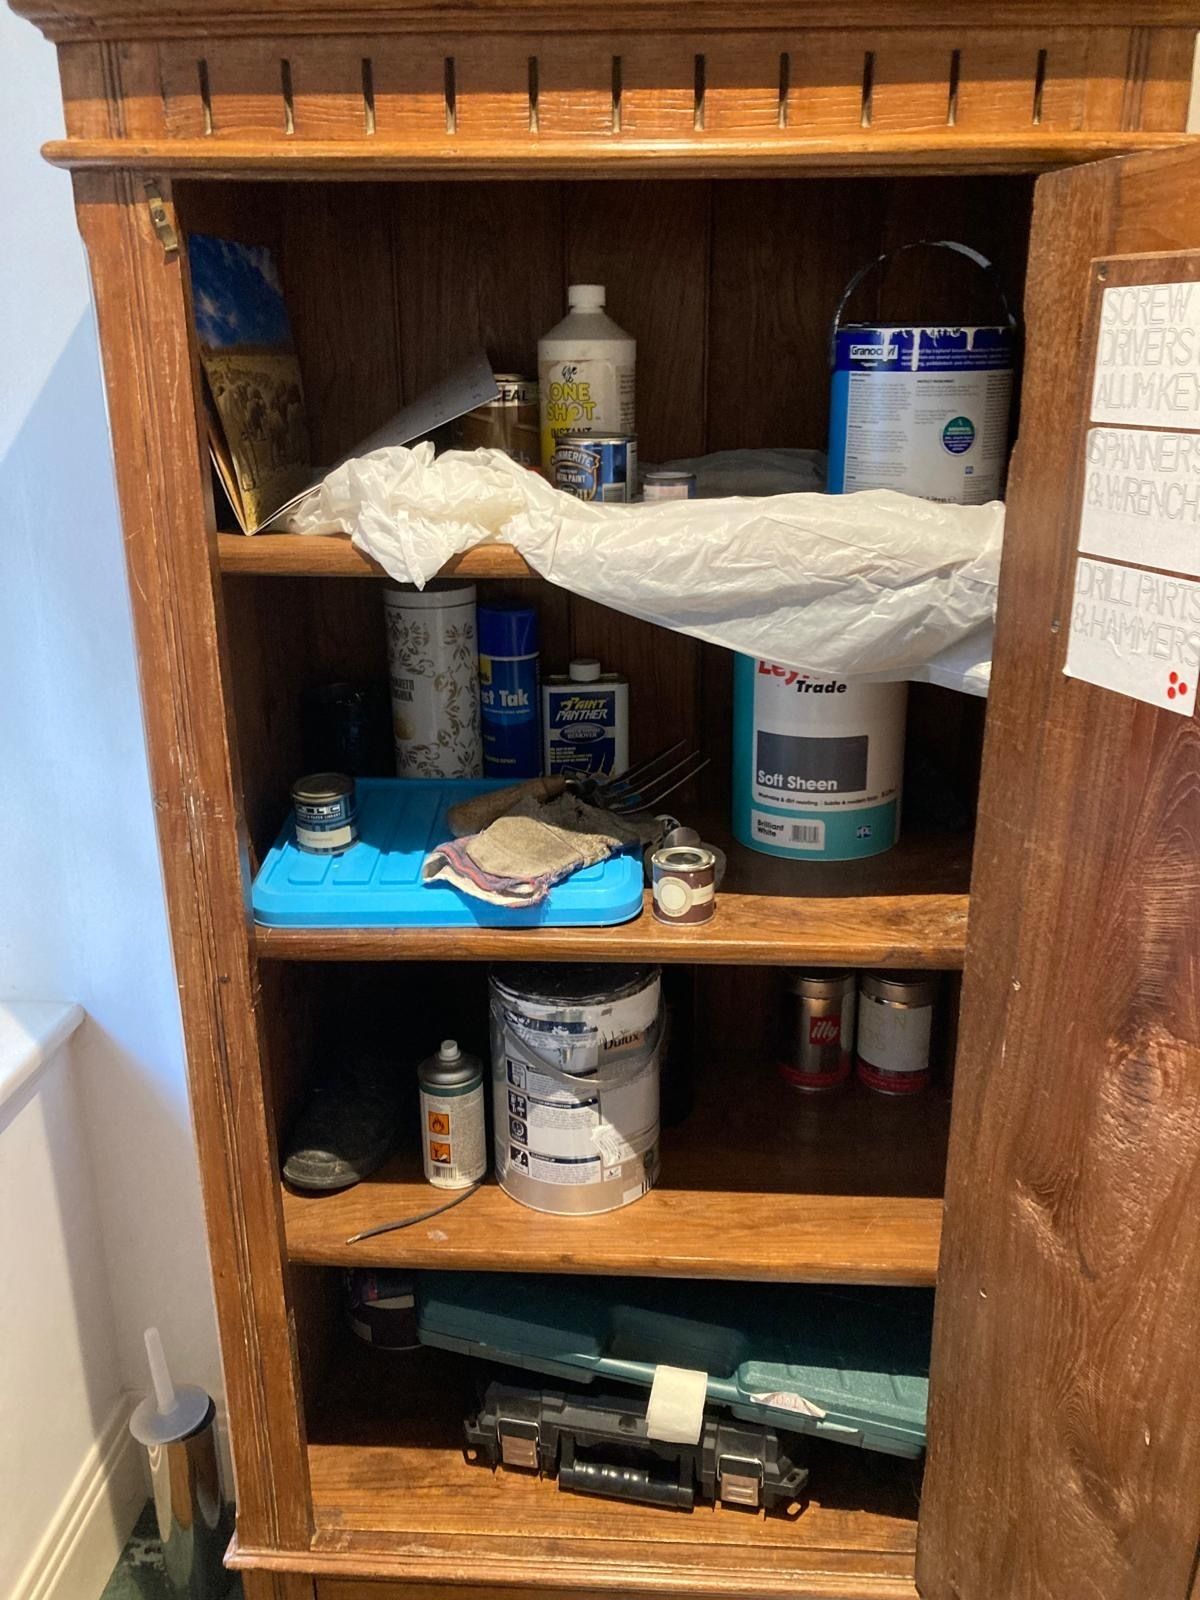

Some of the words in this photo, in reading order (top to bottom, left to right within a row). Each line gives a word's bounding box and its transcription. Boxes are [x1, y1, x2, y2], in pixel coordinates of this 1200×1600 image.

[1103, 285, 1193, 326] SCREW
[851, 345, 896, 359] Granocyl
[1100, 328, 1196, 367] DRIVERS
[549, 382, 592, 401] ONE
[545, 401, 596, 421] SHOT
[1105, 474, 1200, 523] WRENCH
[1089, 603, 1199, 668] HAMMERS
[796, 679, 847, 693] Trade
[499, 688, 529, 707] Tak
[560, 697, 607, 711] PAINT
[555, 709, 608, 722] PANTHER
[758, 770, 784, 787] Soft
[787, 775, 838, 792] Sheen
[757, 818, 785, 832] Brilliant
[811, 1021, 840, 1042] illy
